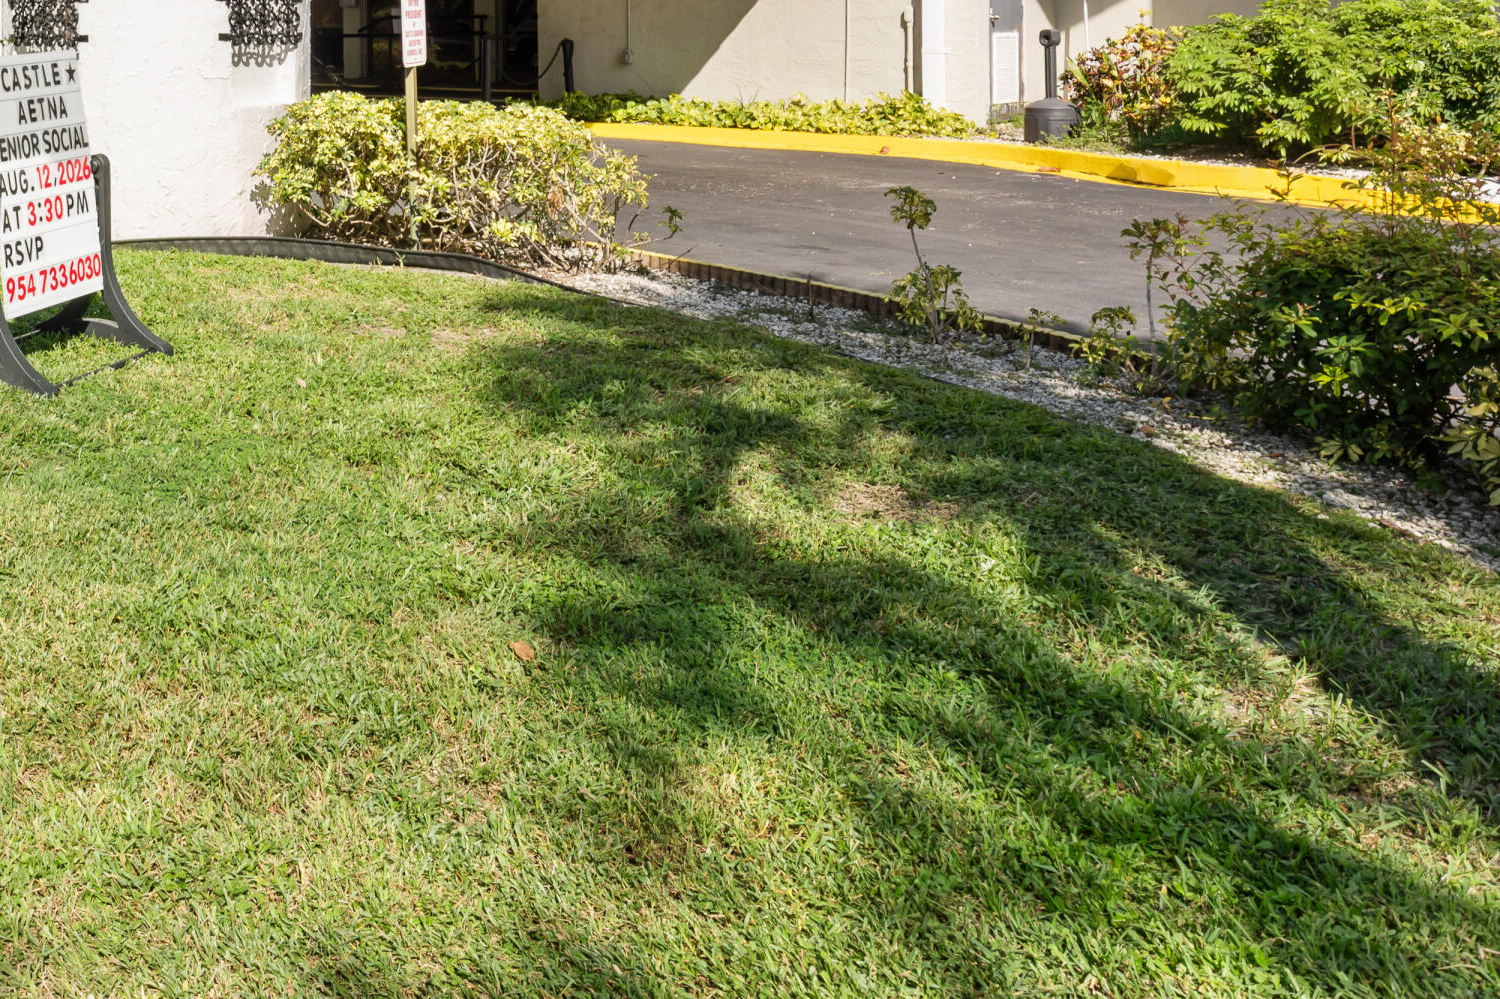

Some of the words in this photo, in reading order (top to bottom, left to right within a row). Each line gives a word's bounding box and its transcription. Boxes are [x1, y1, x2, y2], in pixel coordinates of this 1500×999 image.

[0, 62, 61, 93] CASTLE
[18, 95, 68, 125] AETNA
[42, 125, 90, 154] SOCIAL
[0, 169, 35, 198] AUG.
[3, 205, 21, 234] AT
[3, 236, 44, 269] RSVP
